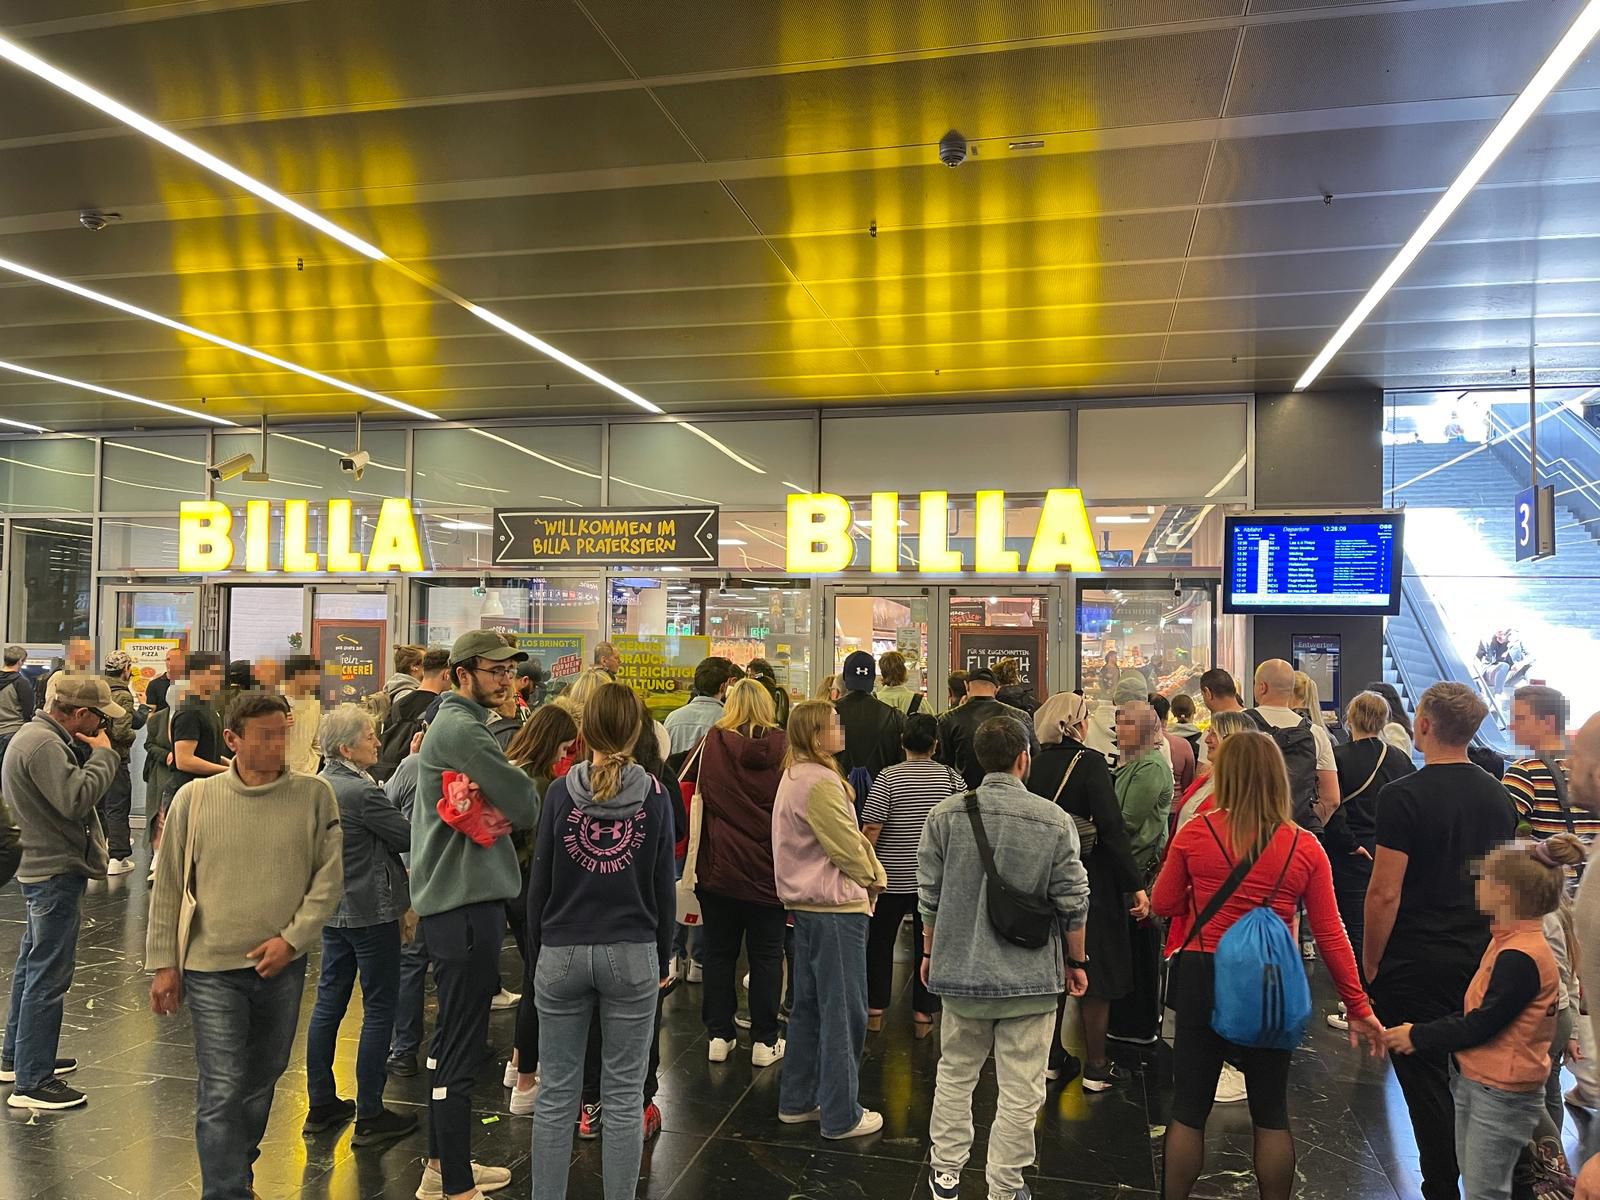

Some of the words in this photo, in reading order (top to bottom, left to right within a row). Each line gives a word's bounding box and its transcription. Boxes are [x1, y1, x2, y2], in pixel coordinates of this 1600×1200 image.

[179, 498, 425, 573] BILLA
[536, 518, 652, 536] WILLKOMMEN
[658, 518, 676, 538] IM
[786, 488, 1102, 573] BILLA
[1520, 503, 1530, 546] 3
[533, 537, 570, 555] BILLA
[577, 536, 676, 556] PRATERSTERN
[332, 664, 373, 675] CKEREI
[616, 666, 637, 677] DIE
[600, 849, 634, 874] NINETY
[630, 832, 646, 849] SIX
